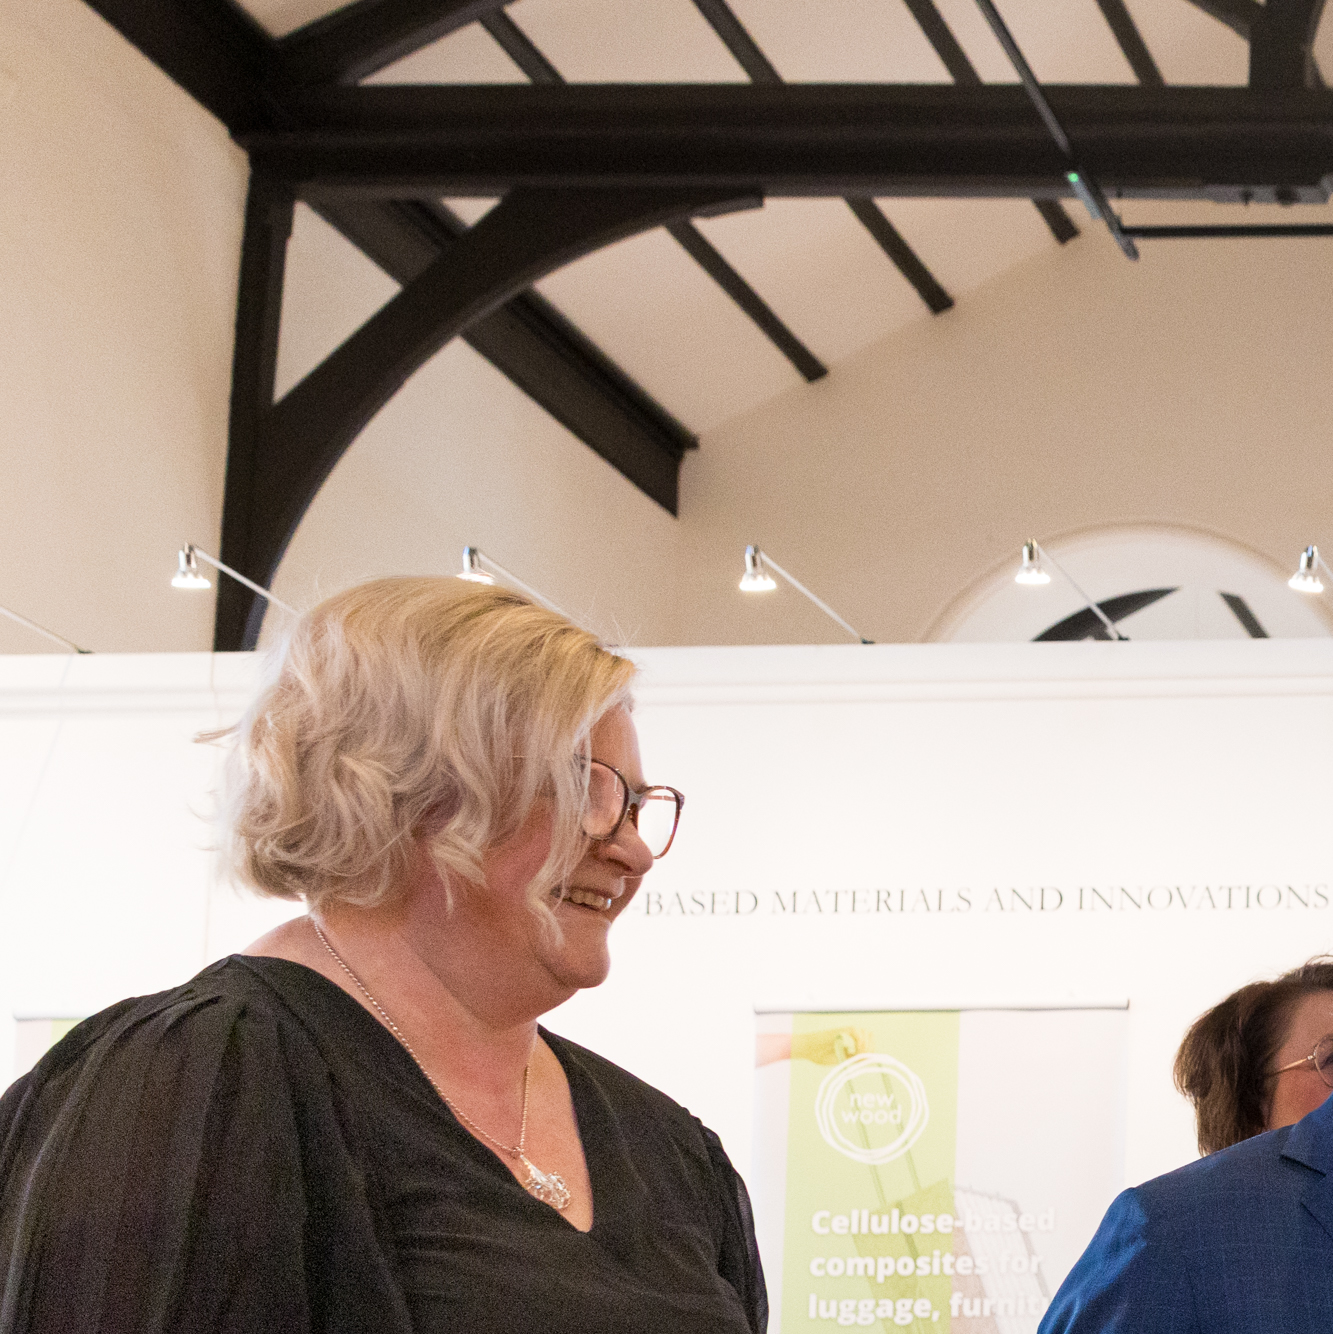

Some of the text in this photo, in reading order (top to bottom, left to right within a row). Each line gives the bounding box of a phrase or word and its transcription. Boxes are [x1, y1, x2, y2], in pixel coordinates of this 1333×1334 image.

[771, 887, 972, 915] MATERIALS
[984, 886, 1063, 912] AND
[1078, 884, 1330, 911] INNOVATIONS
[841, 1103, 902, 1125] wood
[849, 1092, 895, 1108] new
[811, 1208, 1055, 1235] Cellulose-based
[809, 1248, 1043, 1284] composites for
[808, 1291, 1048, 1327] luggage, furnit
